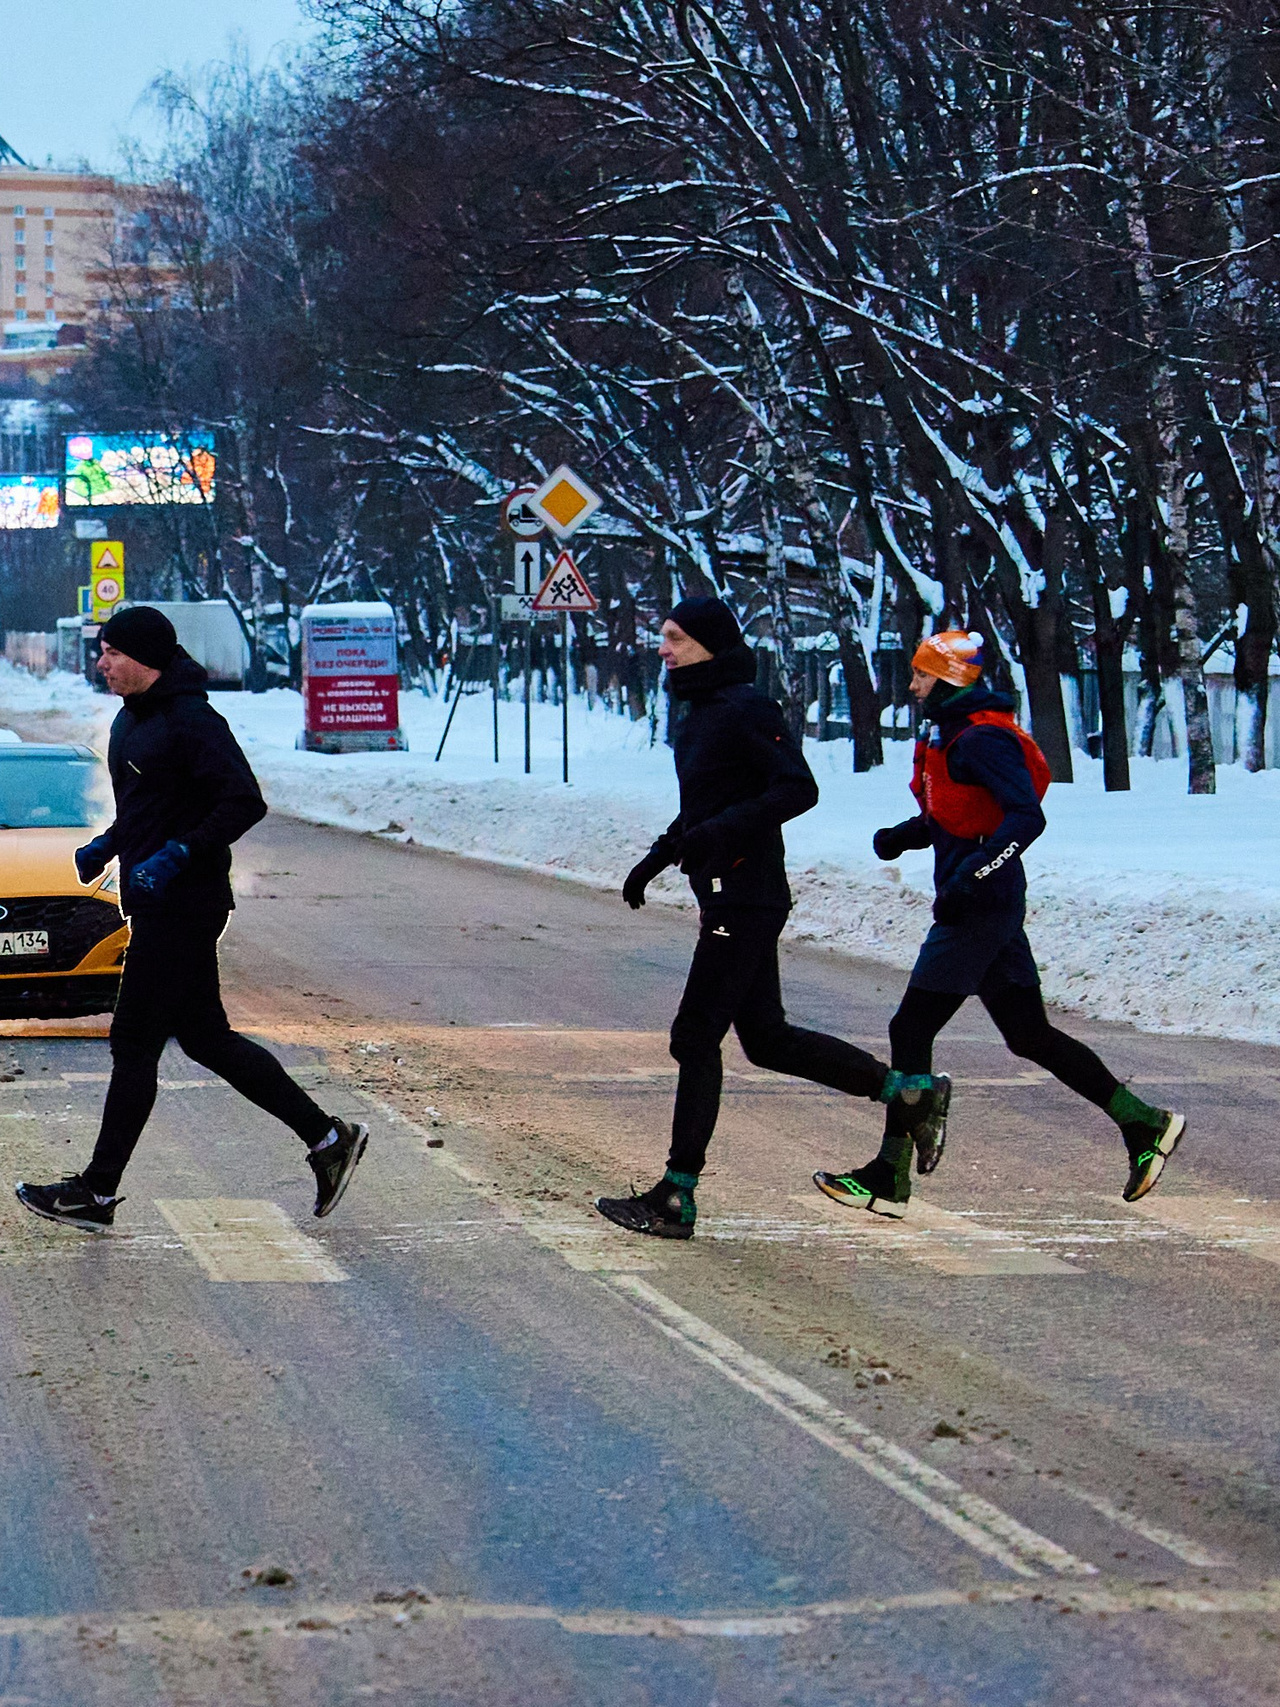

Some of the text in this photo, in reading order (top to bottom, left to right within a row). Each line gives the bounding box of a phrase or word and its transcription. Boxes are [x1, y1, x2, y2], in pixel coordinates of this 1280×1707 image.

[102, 585, 114, 594] 40
[323, 703, 383, 712] НЕ ВЫХОДЯ
[321, 714, 386, 723] ИЗ МАШИНЫ
[16, 932, 47, 948] 134
